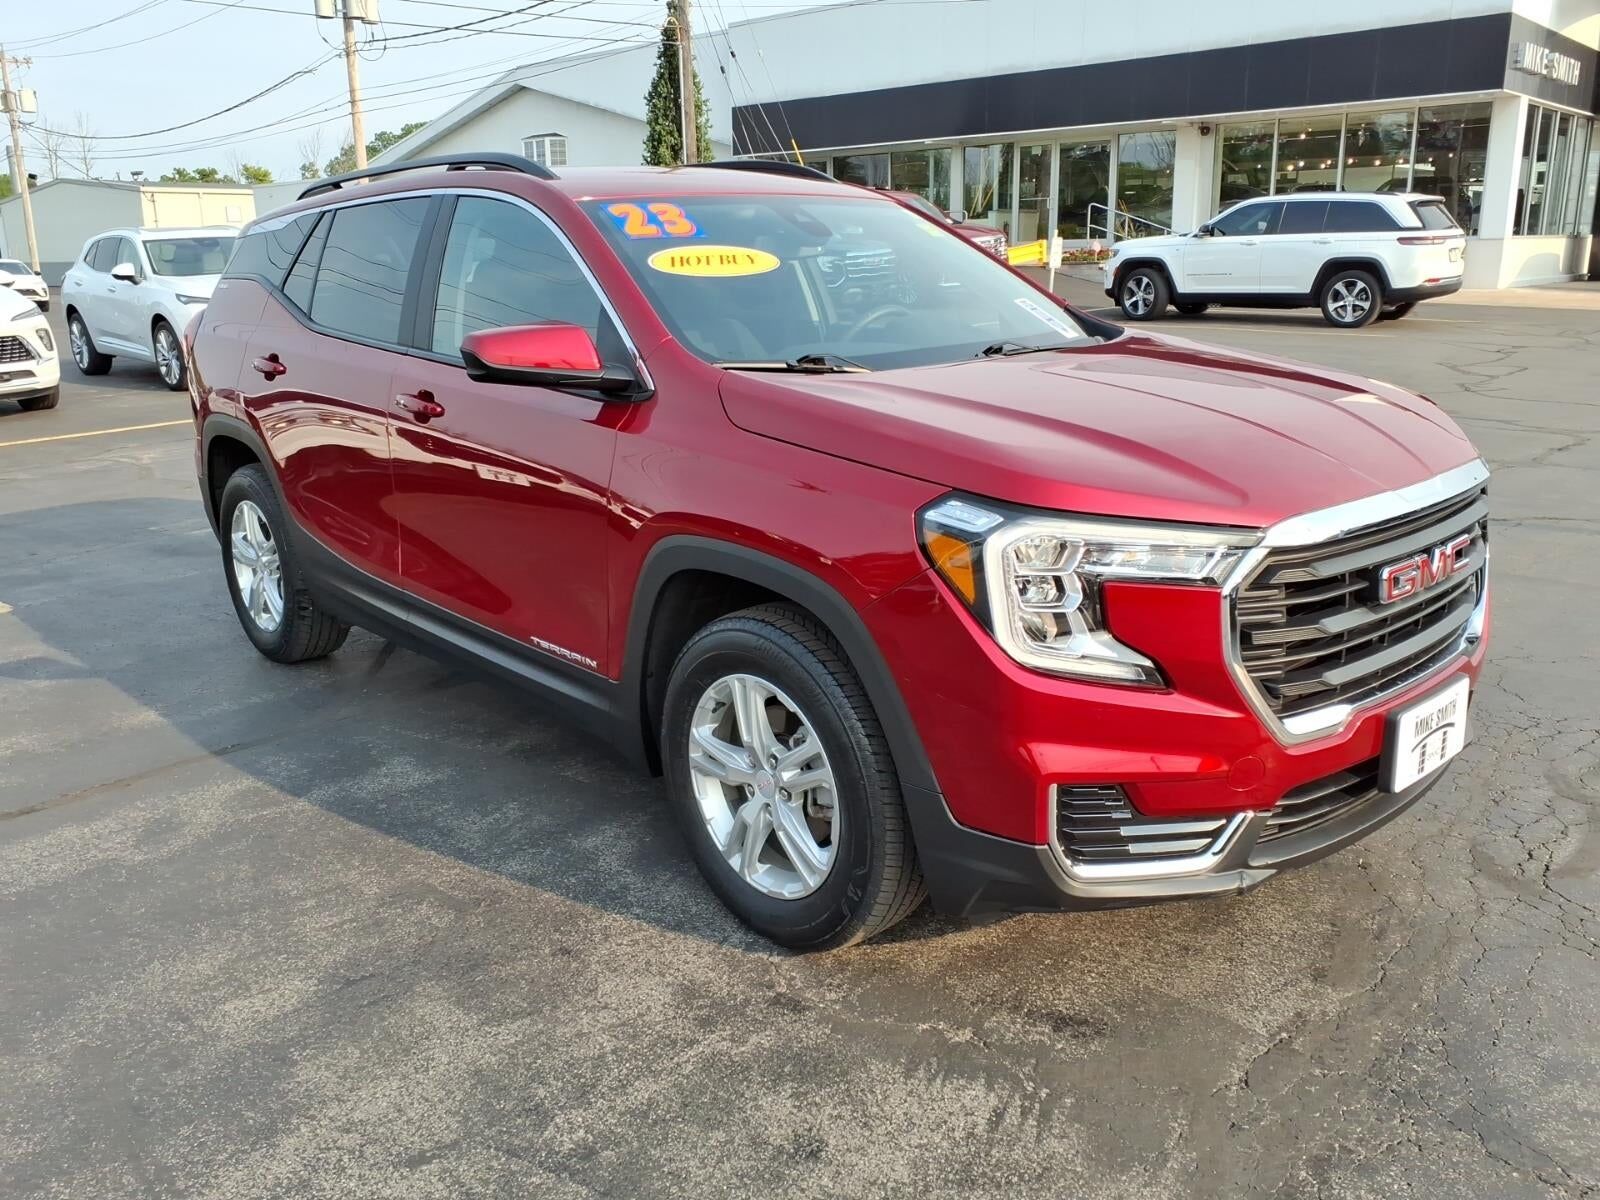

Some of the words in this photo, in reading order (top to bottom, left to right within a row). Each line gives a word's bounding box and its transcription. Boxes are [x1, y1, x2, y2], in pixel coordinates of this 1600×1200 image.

[1523, 42, 1549, 75] MIKE
[1552, 52, 1581, 86] SMITH
[608, 203, 697, 238] 23
[670, 255, 713, 268] HOT
[719, 253, 759, 267] BUY
[1379, 534, 1470, 604] GMC
[530, 635, 598, 670] TERRAIN
[1414, 711, 1435, 738] MIKE
[1436, 698, 1458, 727] SMITH
